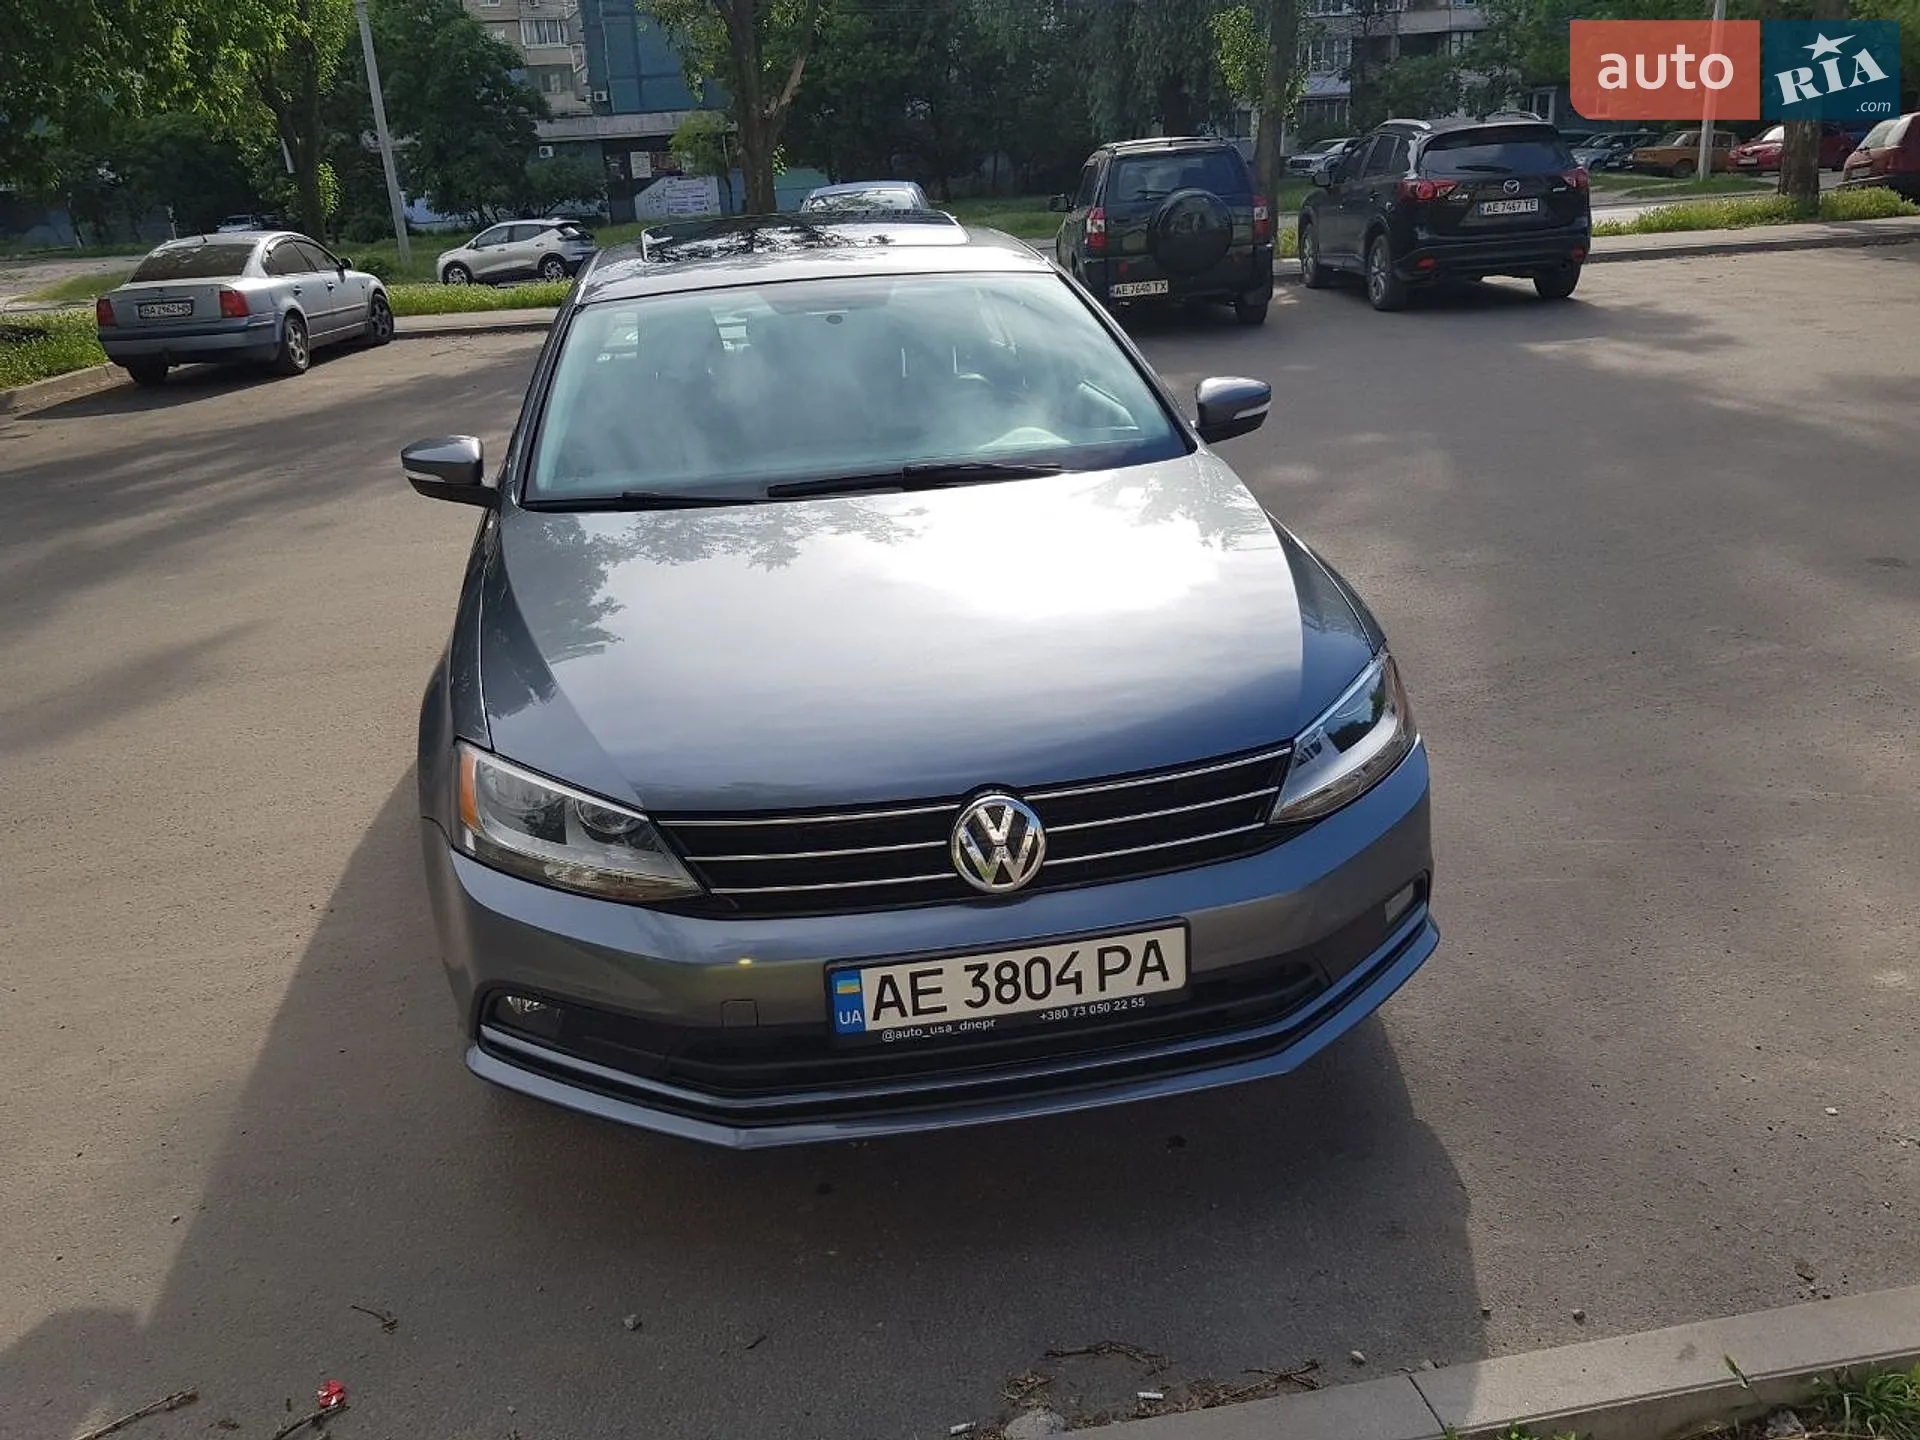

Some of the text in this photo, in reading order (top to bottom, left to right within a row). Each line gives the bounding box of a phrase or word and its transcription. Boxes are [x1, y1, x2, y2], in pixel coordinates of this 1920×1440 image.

[1153, 281, 1167, 293] TX
[872, 938, 1170, 1022] AE 3804 PA
[839, 1009, 863, 1025] UA
[1039, 997, 1146, 1021] +380 73 050 22 55
[881, 1018, 997, 1043] @auto_usa_dnepr
